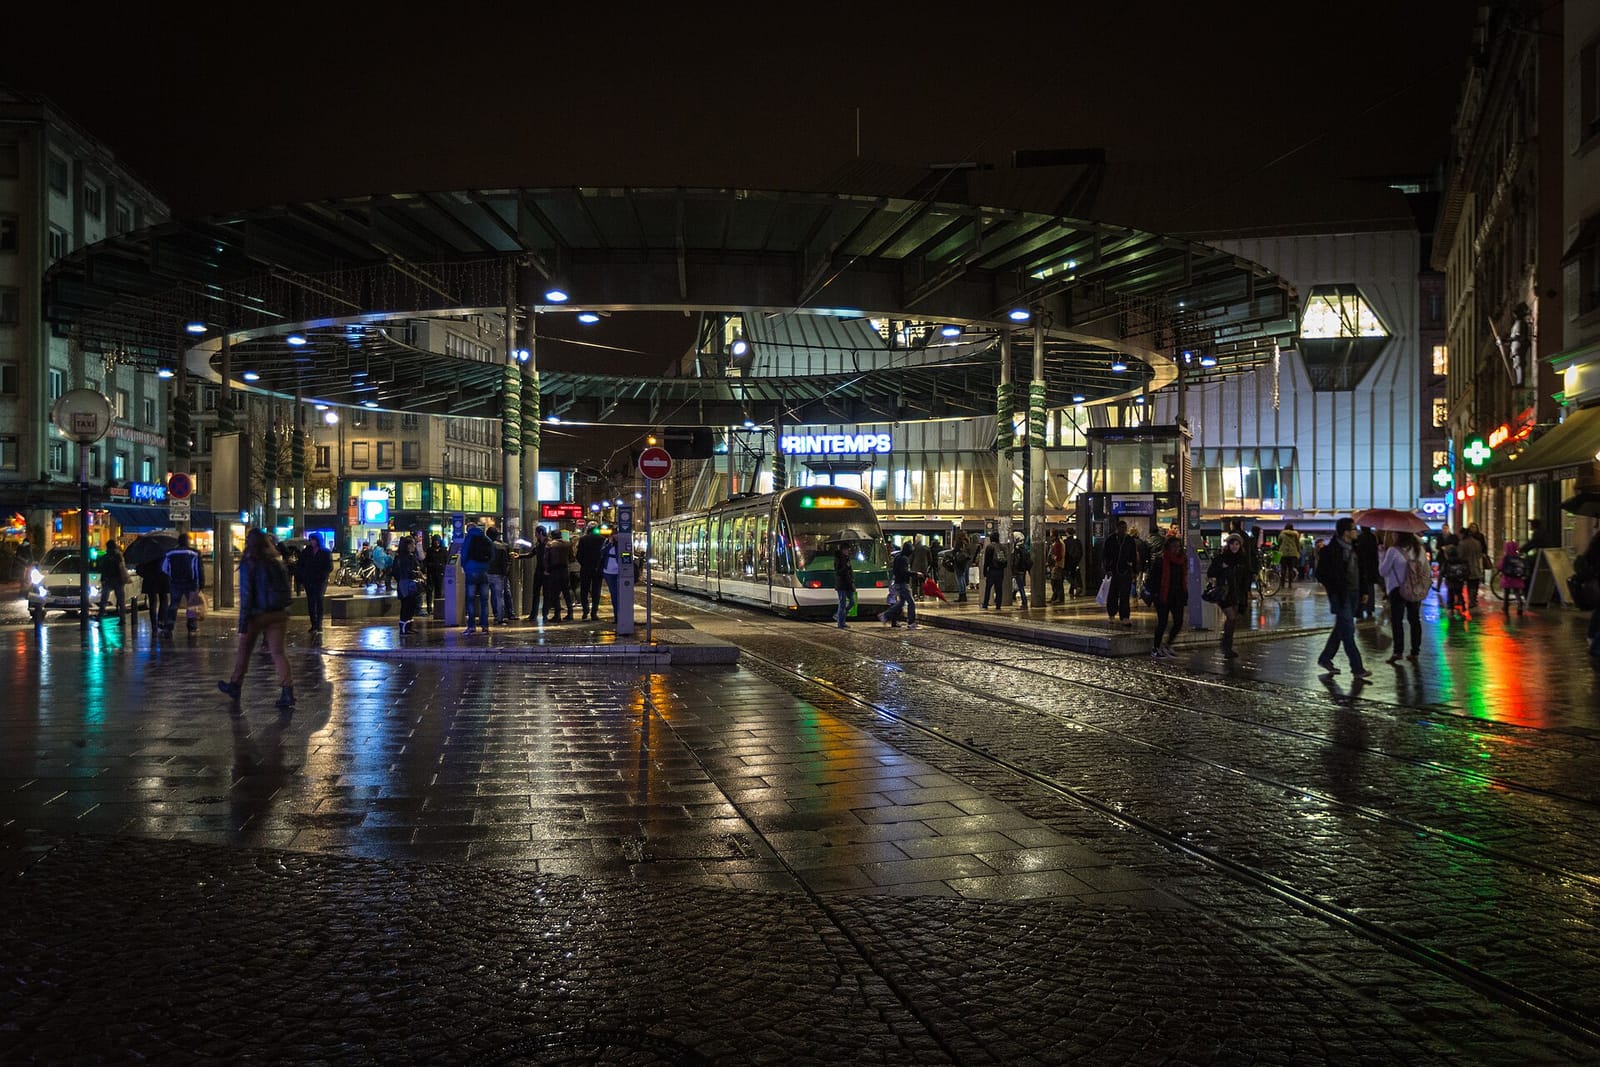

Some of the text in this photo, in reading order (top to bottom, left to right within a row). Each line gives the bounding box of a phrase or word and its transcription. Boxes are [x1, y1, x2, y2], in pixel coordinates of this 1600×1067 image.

[76, 420, 95, 428] TAXI
[1112, 502, 1119, 510] P
[366, 501, 384, 521] P
